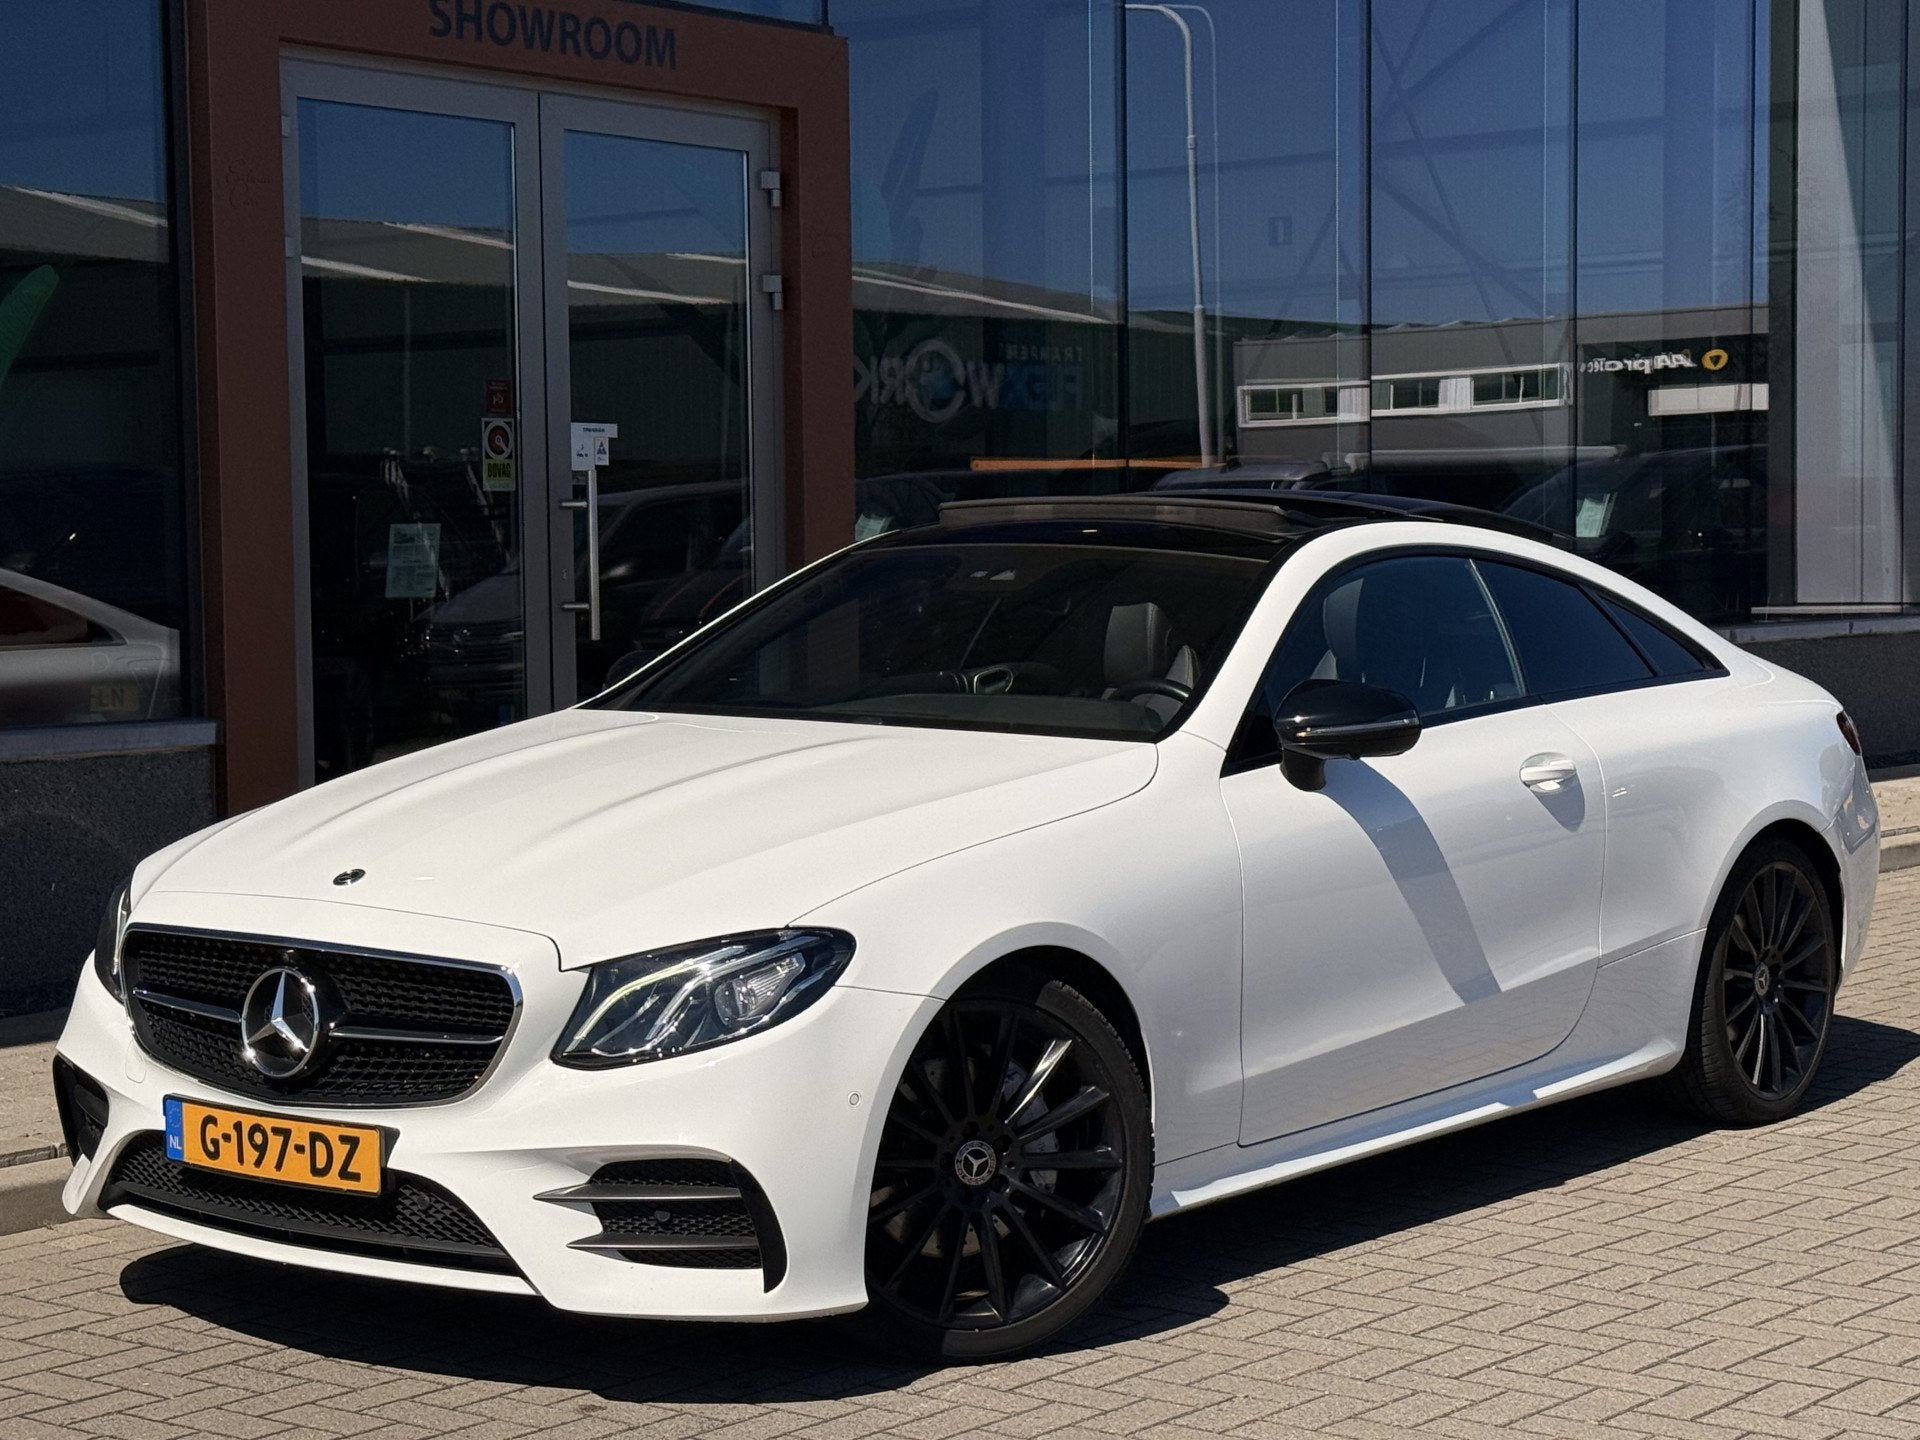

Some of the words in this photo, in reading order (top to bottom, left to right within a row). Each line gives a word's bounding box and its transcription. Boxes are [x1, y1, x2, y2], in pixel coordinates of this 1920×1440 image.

[430, 0, 677, 70] SHOWROOM
[487, 462, 511, 478] BOVAG
[169, 1135, 182, 1150] NL
[200, 1114, 362, 1183] G-197-DZ
